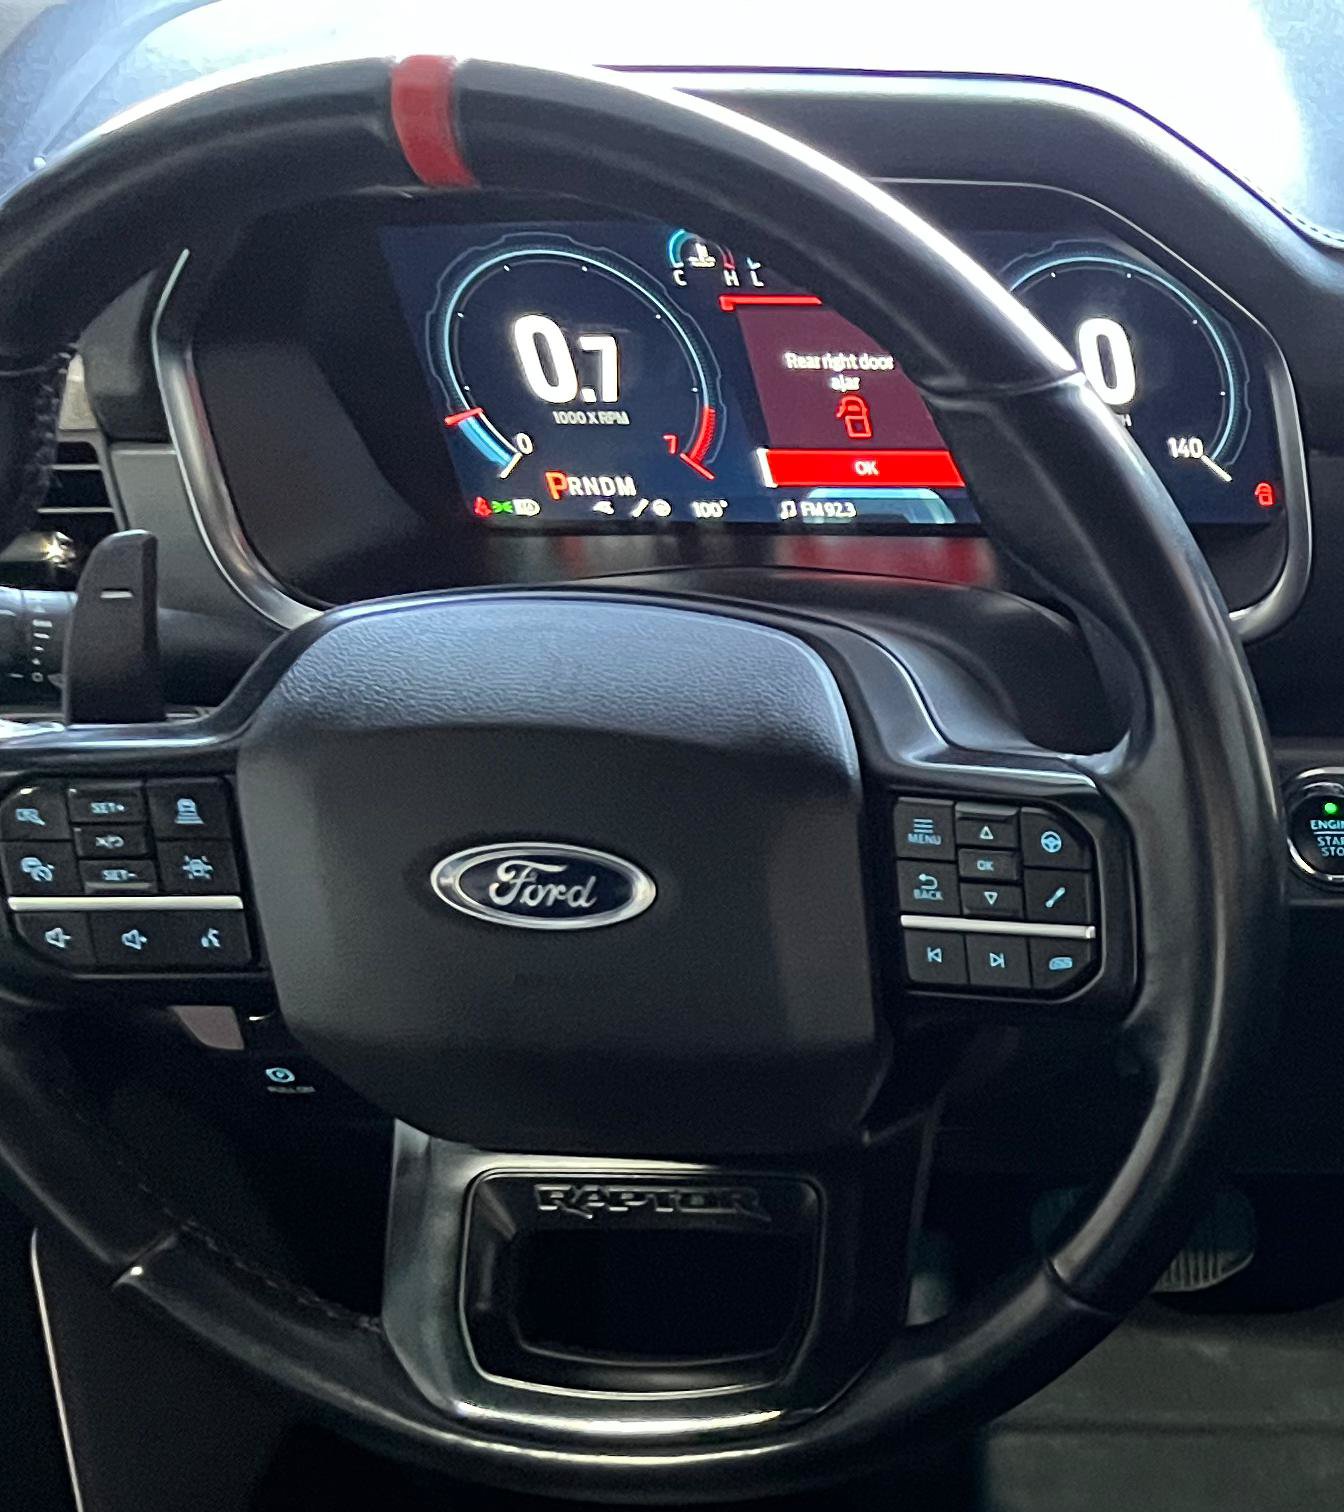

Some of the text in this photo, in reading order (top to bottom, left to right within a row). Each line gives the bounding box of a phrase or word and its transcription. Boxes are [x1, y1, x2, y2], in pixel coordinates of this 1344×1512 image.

[673, 269, 740, 287] C H
[512, 314, 620, 404] 0.7
[784, 352, 895, 371] Rear right door
[1077, 317, 1136, 405] 0
[831, 373, 861, 392] ajar
[552, 411, 587, 425] 1000
[598, 411, 630, 425] RPM
[516, 432, 533, 456] 0
[663, 435, 679, 454] 7
[1167, 437, 1203, 460] 140
[855, 460, 879, 476] OK
[800, 501, 824, 518] FM
[907, 832, 942, 846] MENU
[976, 860, 995, 872] OK
[488, 859, 598, 909] Ford
[912, 888, 944, 902] BACK
[534, 1183, 772, 1222] RAPTOR
